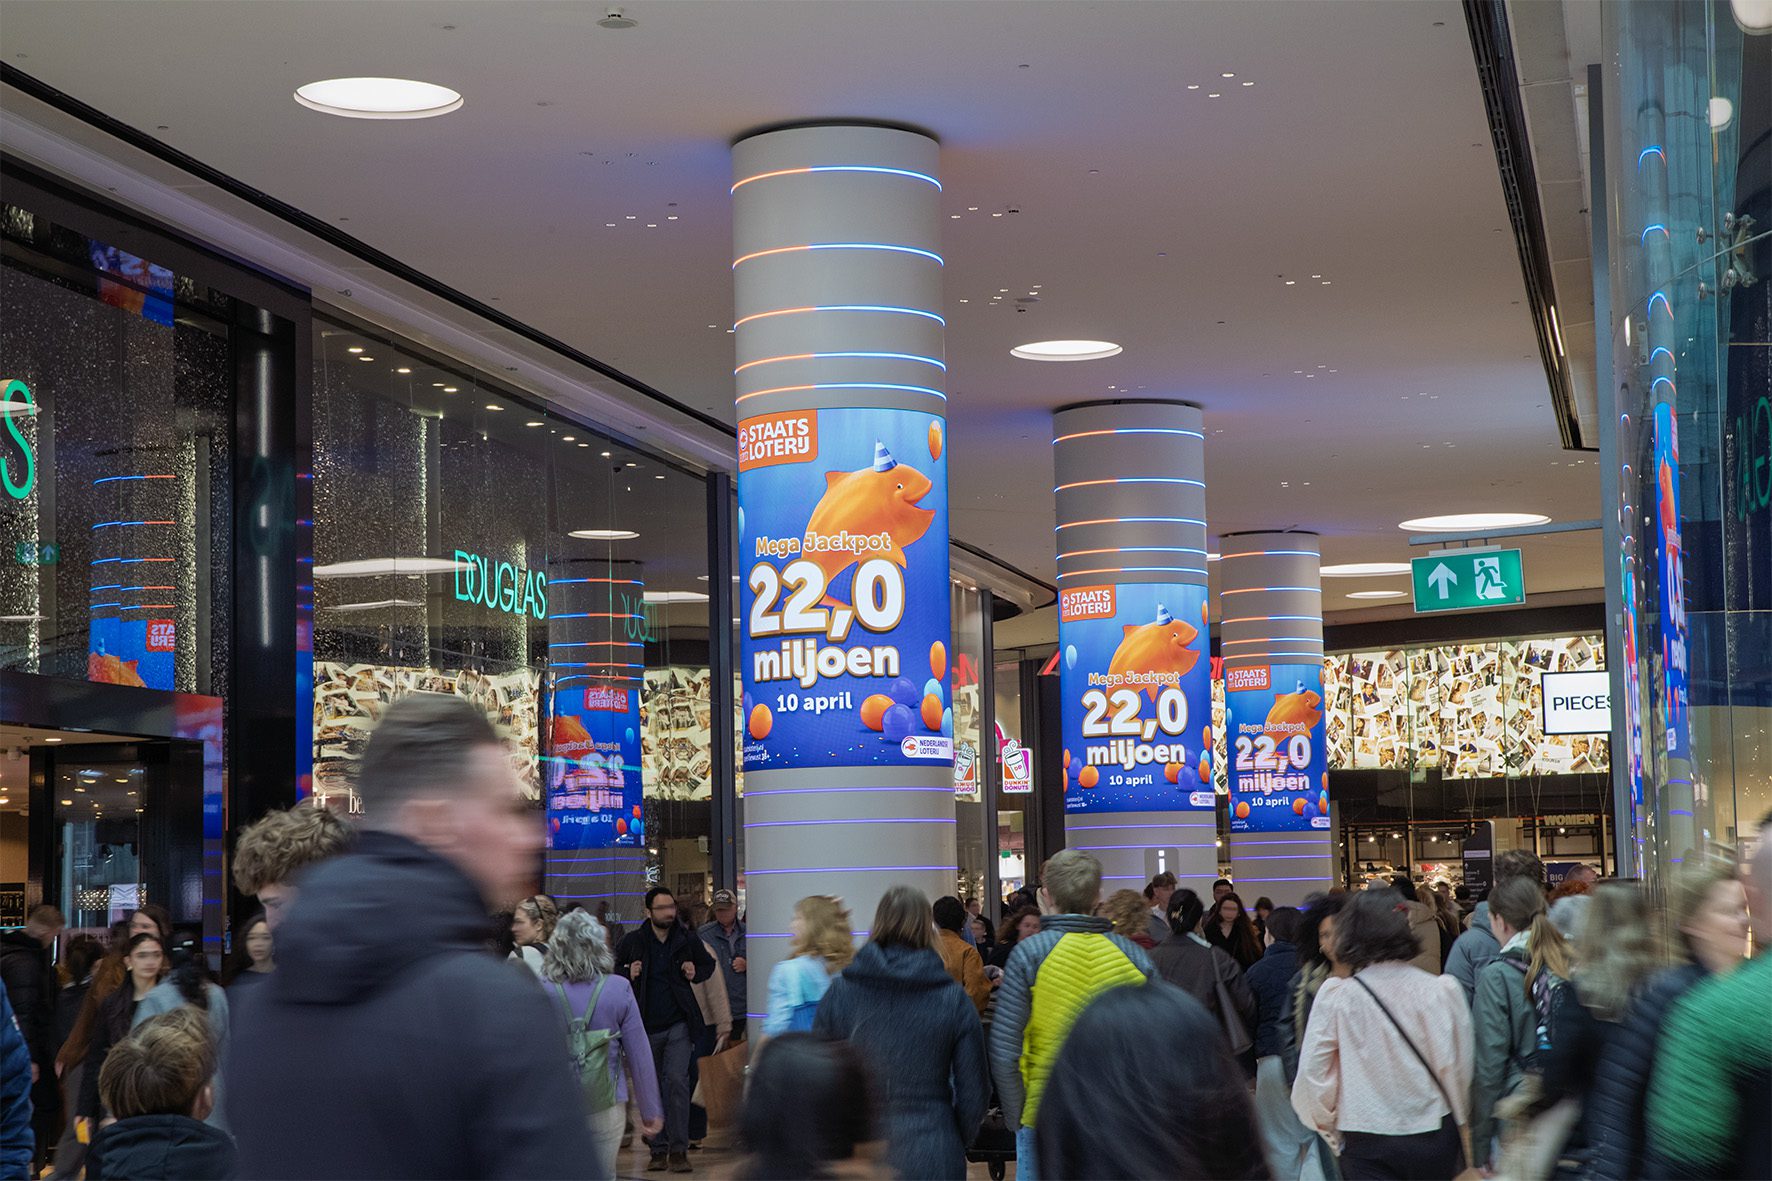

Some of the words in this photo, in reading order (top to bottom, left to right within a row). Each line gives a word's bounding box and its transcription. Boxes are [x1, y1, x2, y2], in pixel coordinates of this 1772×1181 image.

[749, 418, 809, 443] STAATS
[749, 436, 810, 461] LOTERIJ
[756, 536, 801, 558] Mega
[804, 531, 892, 555] Jackpot
[455, 549, 546, 620] DOUGLAS
[750, 559, 905, 642] 22,0
[1070, 590, 1111, 605] STAATS
[1070, 601, 1111, 616] LOTERIJ
[754, 638, 900, 689] miljoen
[1234, 668, 1267, 679] STAATS
[1088, 672, 1124, 687] Mega
[1125, 671, 1180, 686] Jackpot
[1234, 677, 1267, 688] LOTERIJ
[777, 694, 798, 712] 10
[803, 692, 853, 715] april
[1081, 688, 1188, 742] 22,0
[1239, 723, 1263, 734] Mega
[1265, 721, 1305, 733] Jackpot
[1086, 738, 1186, 771] miljoen
[1235, 734, 1311, 774] 22,0
[1109, 775, 1123, 785] 10
[1126, 774, 1153, 787] april
[1239, 772, 1310, 796] miljoen
[1252, 797, 1263, 806] 10
[1265, 797, 1289, 807] april
[1544, 814, 1595, 826] WOMEN
[1550, 873, 1564, 881] BIG
